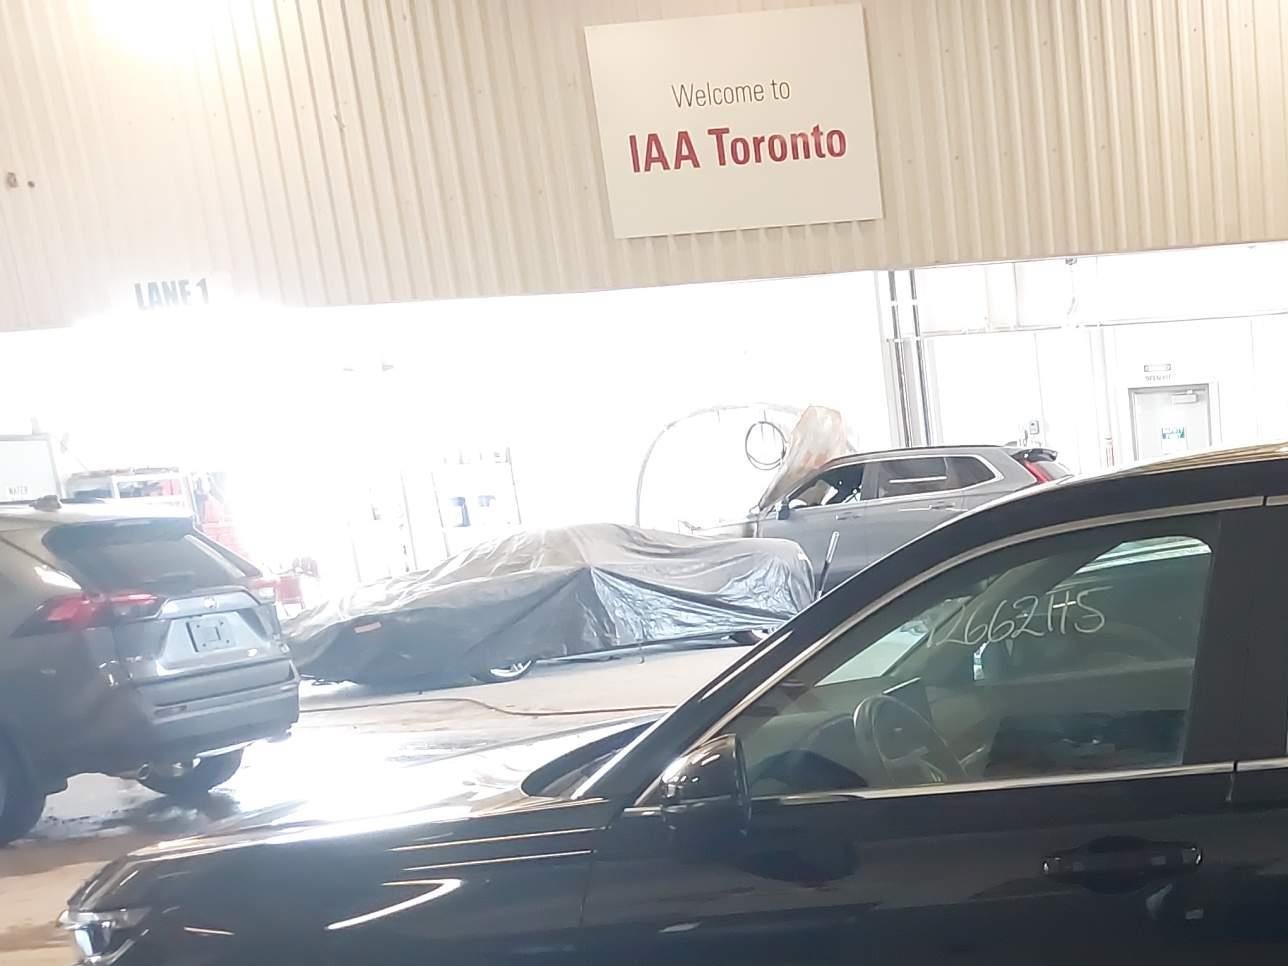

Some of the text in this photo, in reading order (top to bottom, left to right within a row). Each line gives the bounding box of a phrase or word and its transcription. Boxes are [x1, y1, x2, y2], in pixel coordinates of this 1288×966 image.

[671, 79, 791, 108] Welcome to
[629, 124, 847, 173] IAA Toronto
[134, 277, 209, 311] LANE 1
